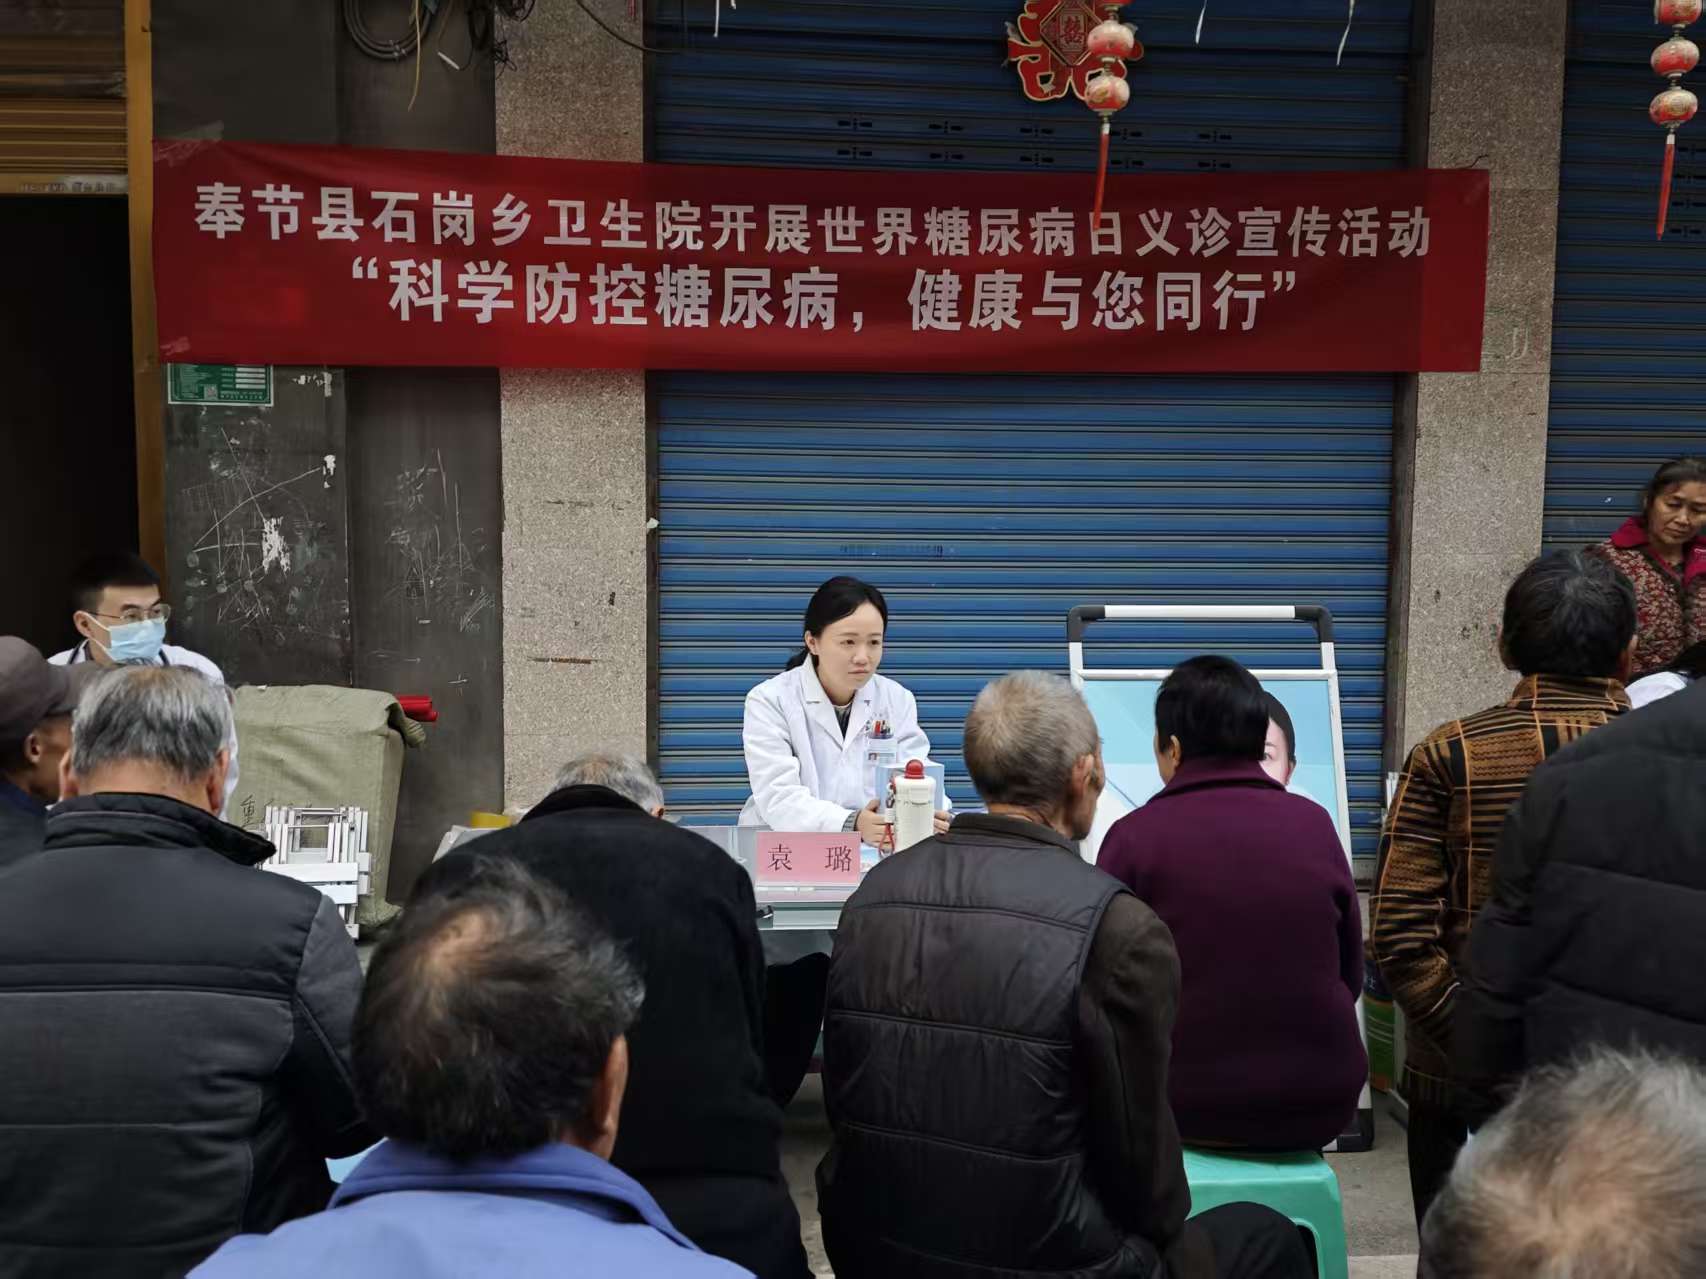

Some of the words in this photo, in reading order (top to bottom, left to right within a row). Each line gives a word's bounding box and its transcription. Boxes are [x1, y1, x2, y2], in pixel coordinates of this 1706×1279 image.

[194, 182, 1430, 258] 奉节县石岗乡卫生院开展世界糖尿病日义诊宣传活动
